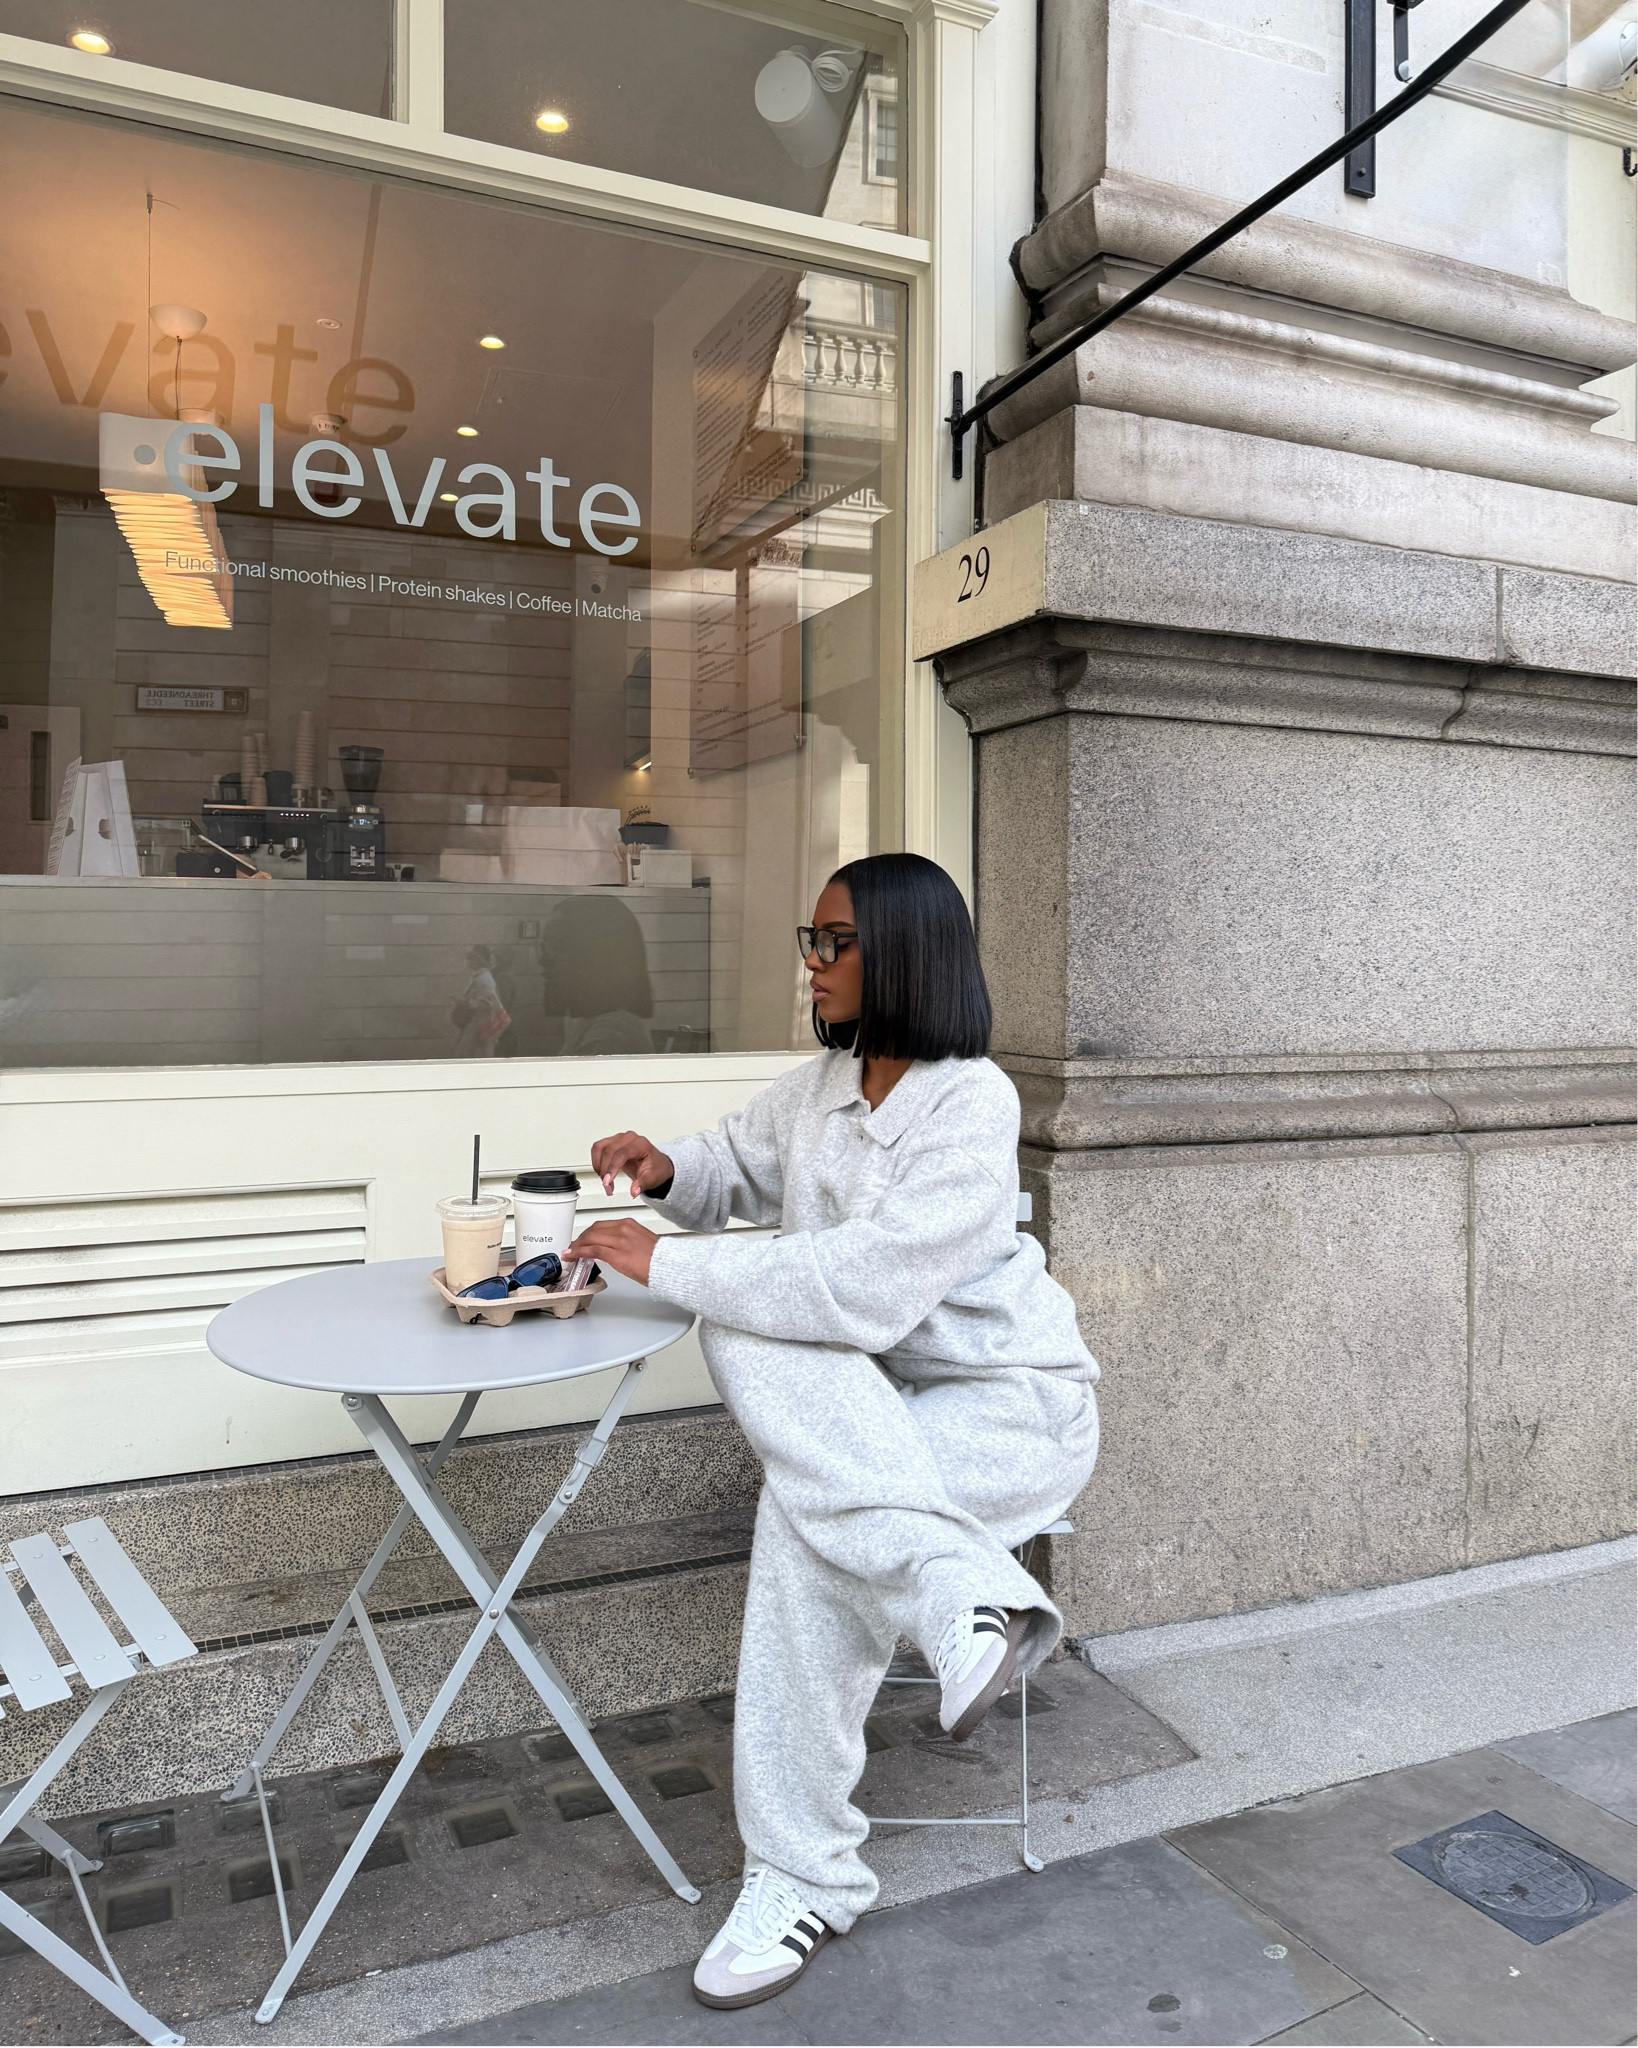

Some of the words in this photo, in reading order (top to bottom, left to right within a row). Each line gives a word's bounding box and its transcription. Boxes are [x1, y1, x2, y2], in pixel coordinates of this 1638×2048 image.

[164, 403, 641, 556] elevate
[165, 550, 266, 579] Functional
[270, 566, 367, 590] smoothies
[378, 575, 442, 599] Protein
[445, 585, 506, 606] shakes
[516, 592, 572, 614] Coffee
[582, 600, 642, 622] Matcha
[957, 546, 990, 603] 29
[522, 1234, 554, 1243] elevate
